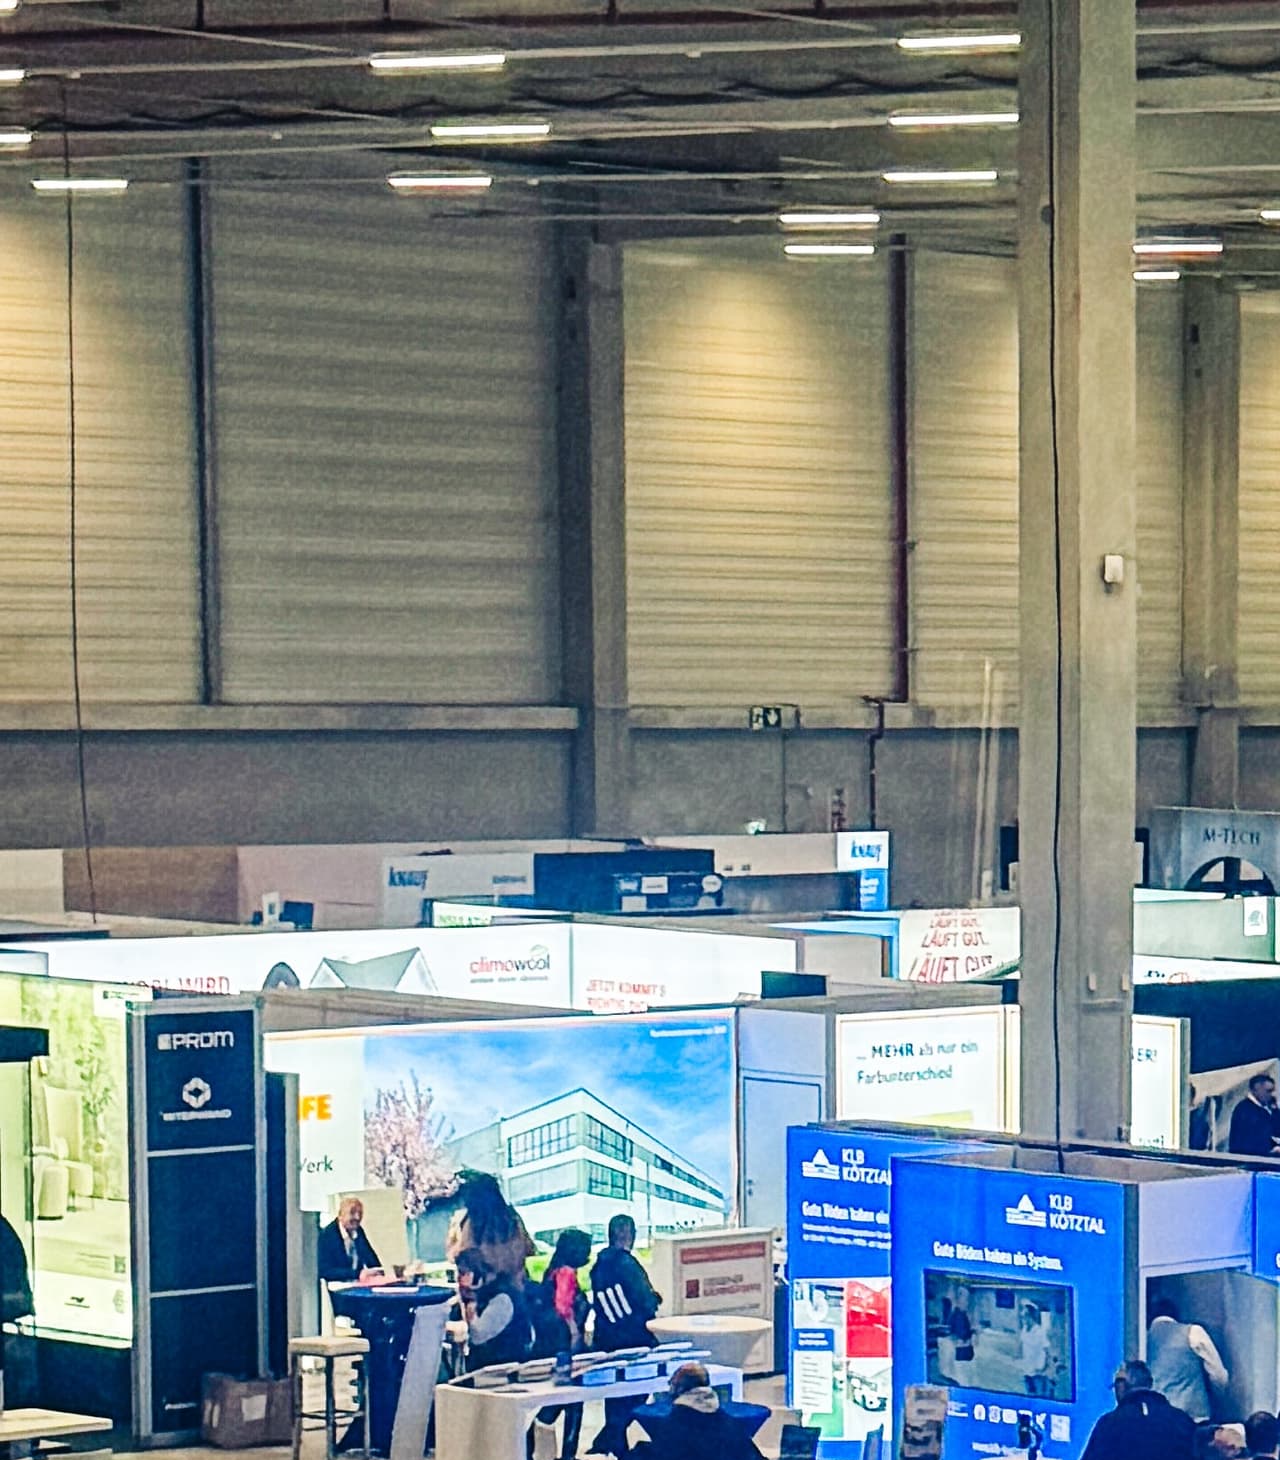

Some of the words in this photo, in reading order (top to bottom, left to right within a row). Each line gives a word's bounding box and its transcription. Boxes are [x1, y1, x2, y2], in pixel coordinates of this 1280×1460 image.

[872, 1043, 914, 1058] MEHR
[842, 1148, 864, 1165] KLB
[1049, 1194, 1073, 1211] KLB
[1050, 1211, 1106, 1234] KÖTZTAL
